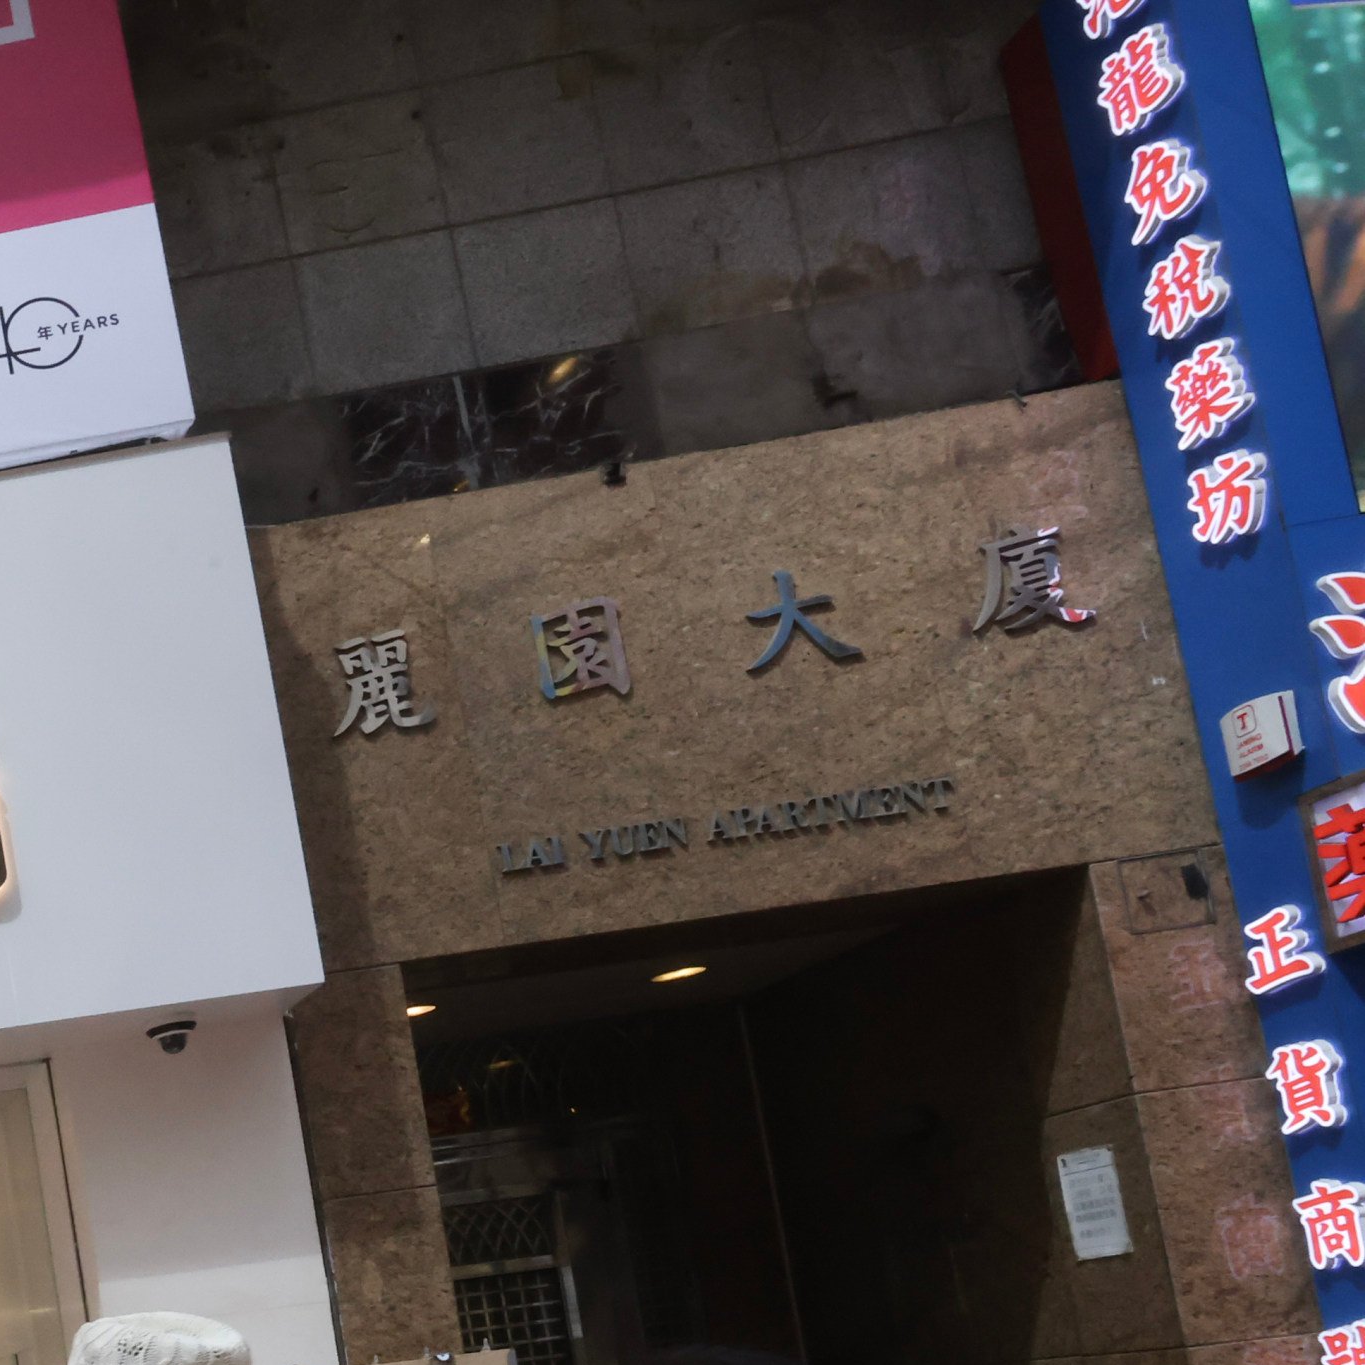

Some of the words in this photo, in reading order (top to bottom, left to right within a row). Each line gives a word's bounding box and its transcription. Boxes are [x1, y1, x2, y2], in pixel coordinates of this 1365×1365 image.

[55, 312, 121, 338] YEARS
[334, 526, 1096, 737] 麗園大廈
[499, 834, 564, 874] LAI
[579, 819, 689, 862] YUEN
[706, 777, 954, 843] APARTMENT
